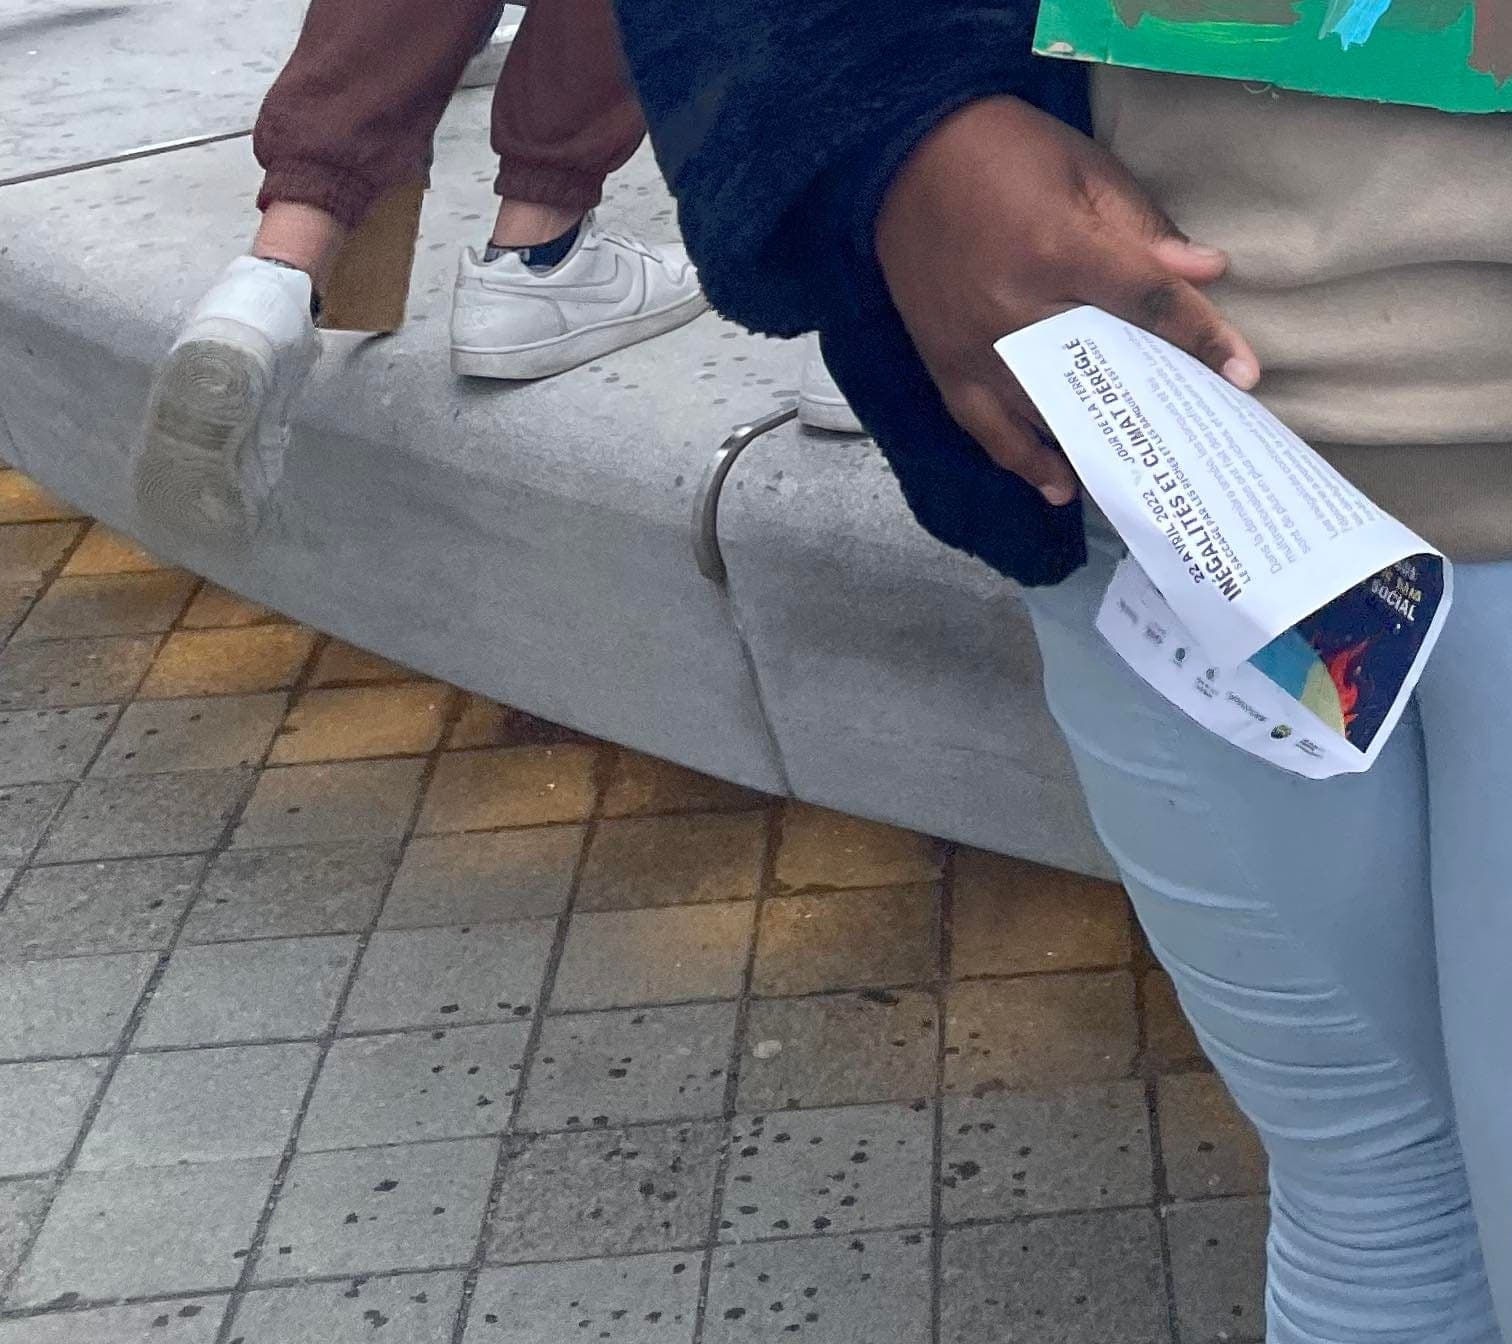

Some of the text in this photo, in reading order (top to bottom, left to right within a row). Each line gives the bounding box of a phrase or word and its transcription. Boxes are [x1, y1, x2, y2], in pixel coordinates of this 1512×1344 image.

[1063, 338, 1118, 404] DÉRÉGLÉ
[1110, 409, 1159, 467] CLIMAT
[1147, 429, 1163, 447] LES
[1158, 446, 1171, 456] ET
[1064, 370, 1205, 583] 22 AVRIL 2022 JOUR DE LA TERRE
[1153, 472, 1177, 493] ET
[1167, 457, 1192, 490] RICHES
[1187, 490, 1202, 507] LES
[1199, 507, 1215, 526] PAR
[1169, 496, 1241, 602] INÉGALITÉS
[1210, 526, 1243, 570] SACCAGE
[1239, 568, 1251, 584] LE
